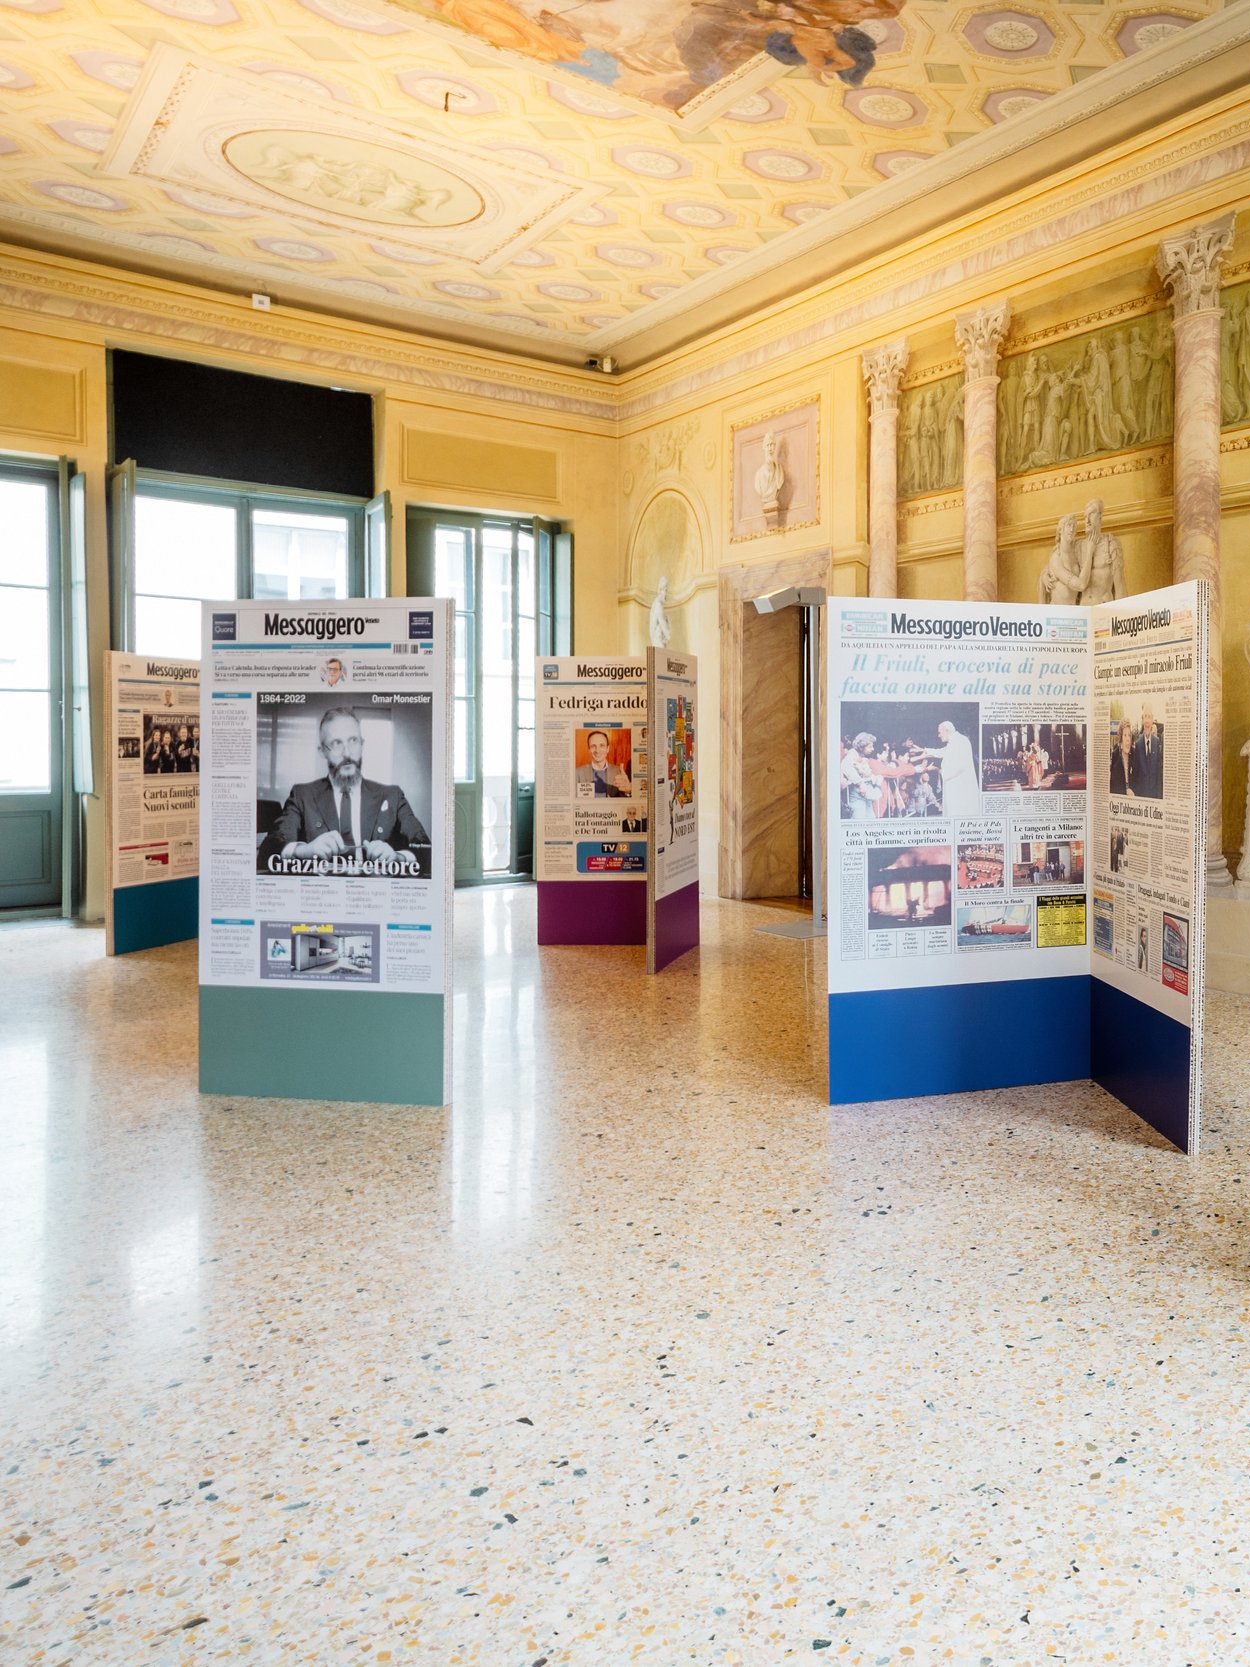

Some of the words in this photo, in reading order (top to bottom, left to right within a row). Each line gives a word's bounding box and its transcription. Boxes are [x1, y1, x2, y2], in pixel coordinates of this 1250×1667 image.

[264, 614, 364, 640] Messaggero
[147, 662, 197, 680] Messaggero
[577, 665, 642, 679] Messaggero
[851, 654, 866, 671] Il
[874, 655, 930, 675] Friuli,
[938, 657, 1011, 673] crocevia
[1018, 658, 1034, 674] di
[1039, 664, 1078, 678] pace
[839, 678, 898, 697] faccia
[905, 682, 956, 695] onore
[963, 680, 996, 695] alla
[1002, 684, 1032, 695] sua
[1039, 680, 1087, 696] storia
[372, 695, 392, 703] Omar
[394, 695, 430, 703] Monestier
[550, 697, 603, 711] Fedriga
[144, 788, 167, 799] Carta
[144, 801, 169, 812] Nuovi
[171, 799, 195, 809] sconti
[575, 811, 617, 819] Ballottaggio
[268, 854, 329, 873] Grazie
[332, 855, 420, 875] Direttore
